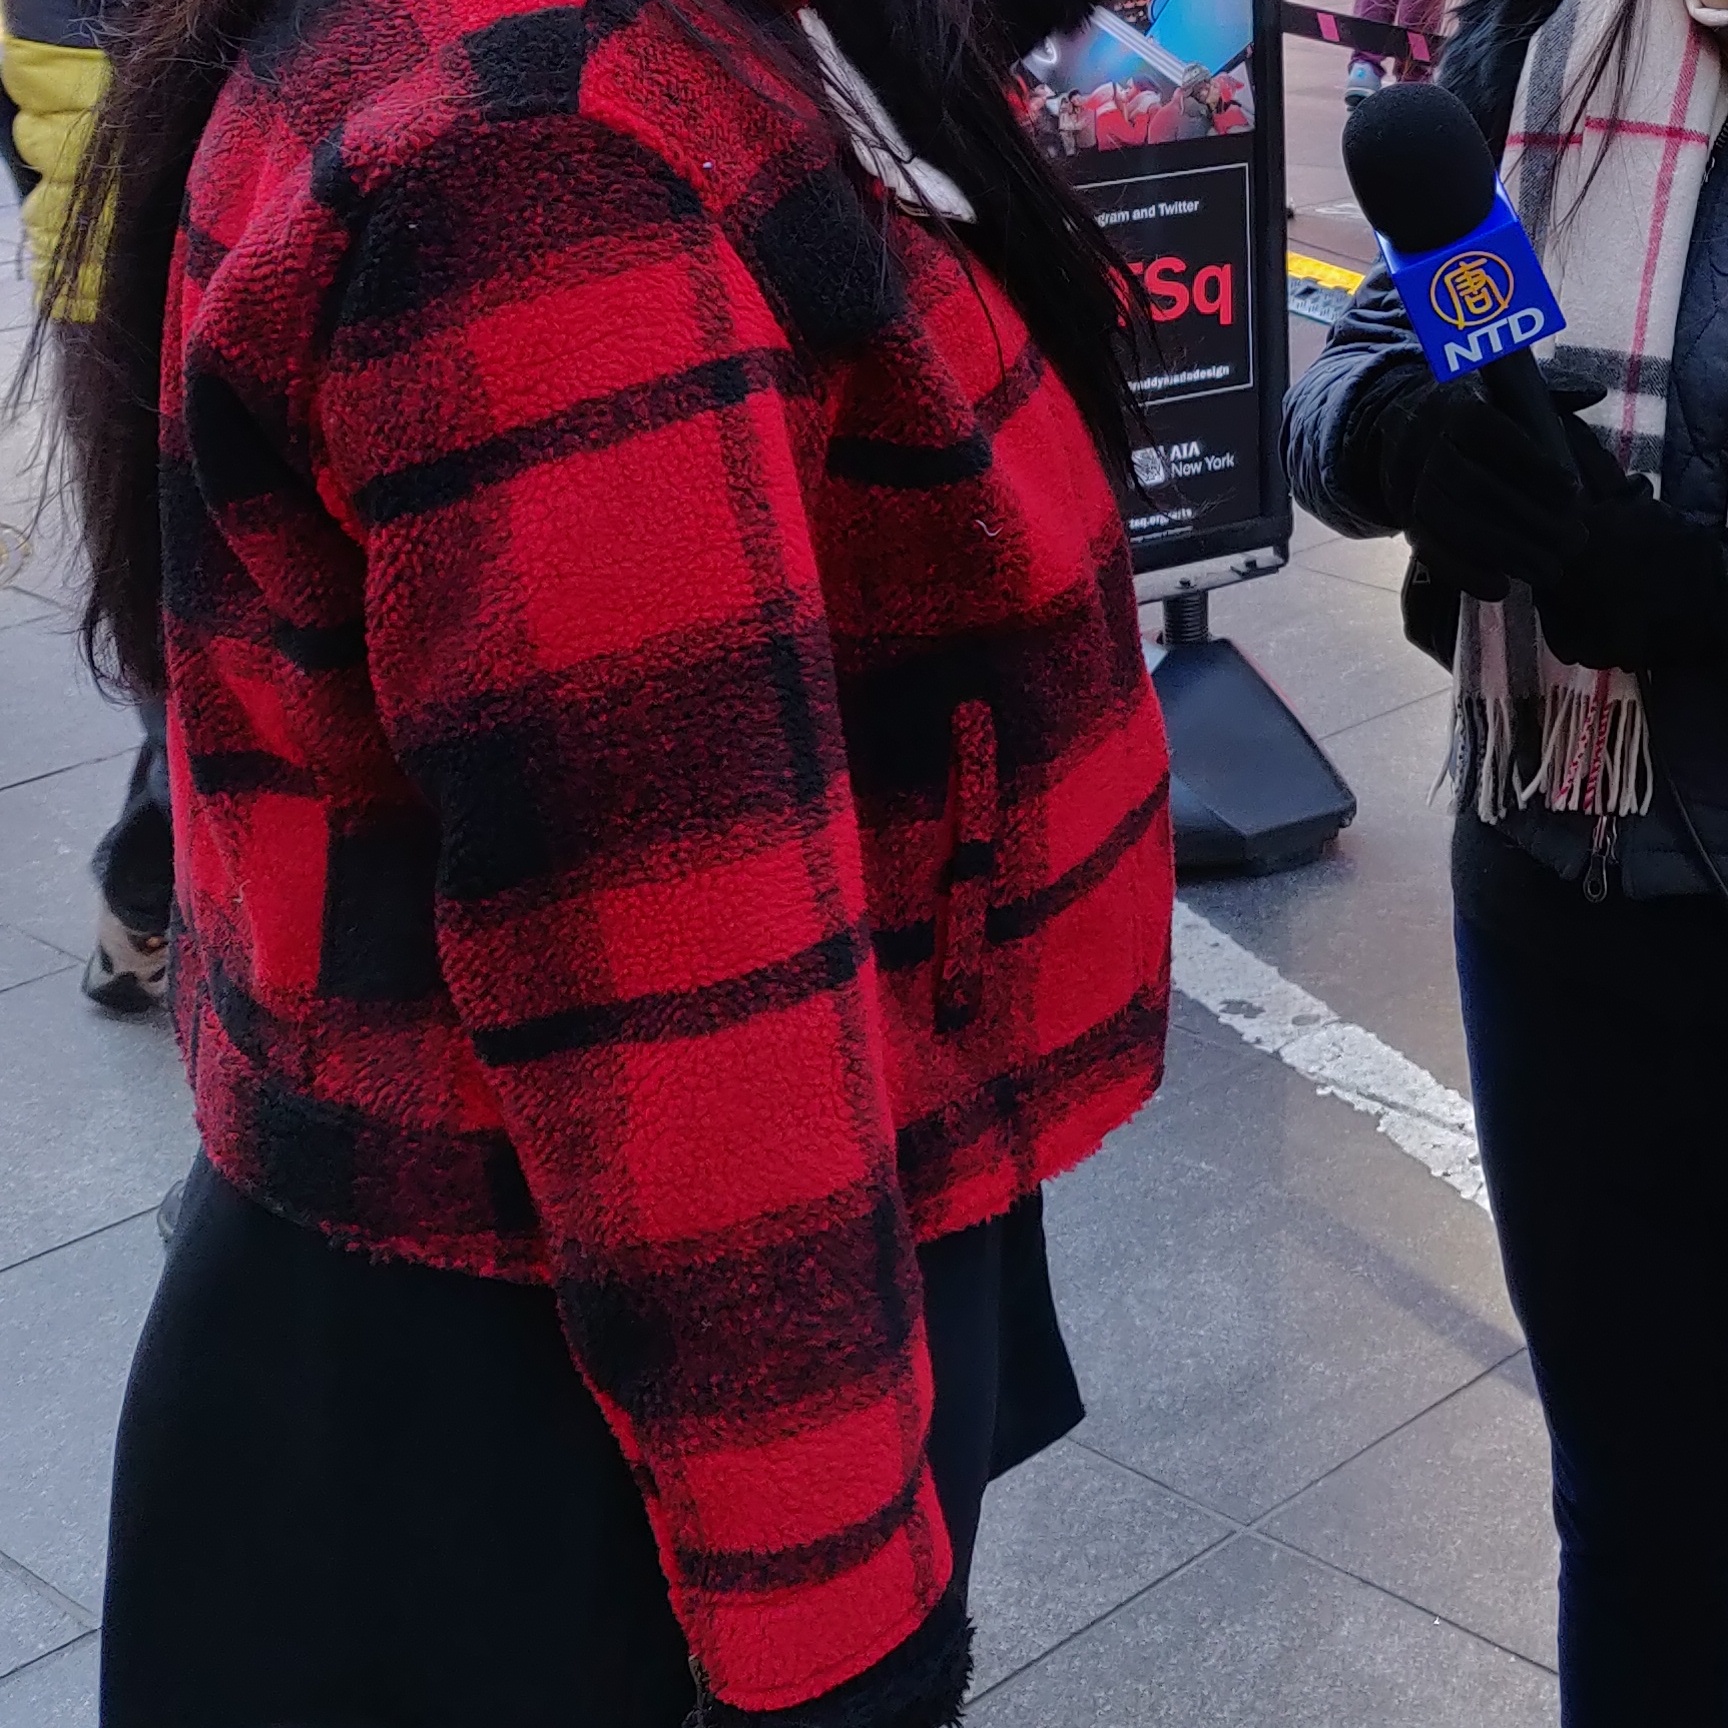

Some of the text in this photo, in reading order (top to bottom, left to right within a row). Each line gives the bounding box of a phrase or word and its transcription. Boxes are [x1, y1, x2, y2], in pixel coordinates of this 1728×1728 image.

[1097, 200, 1200, 228] gram and Twitter
[1444, 307, 1546, 373] NTD
[1170, 441, 1200, 462] AIA
[1171, 452, 1235, 479] New York
